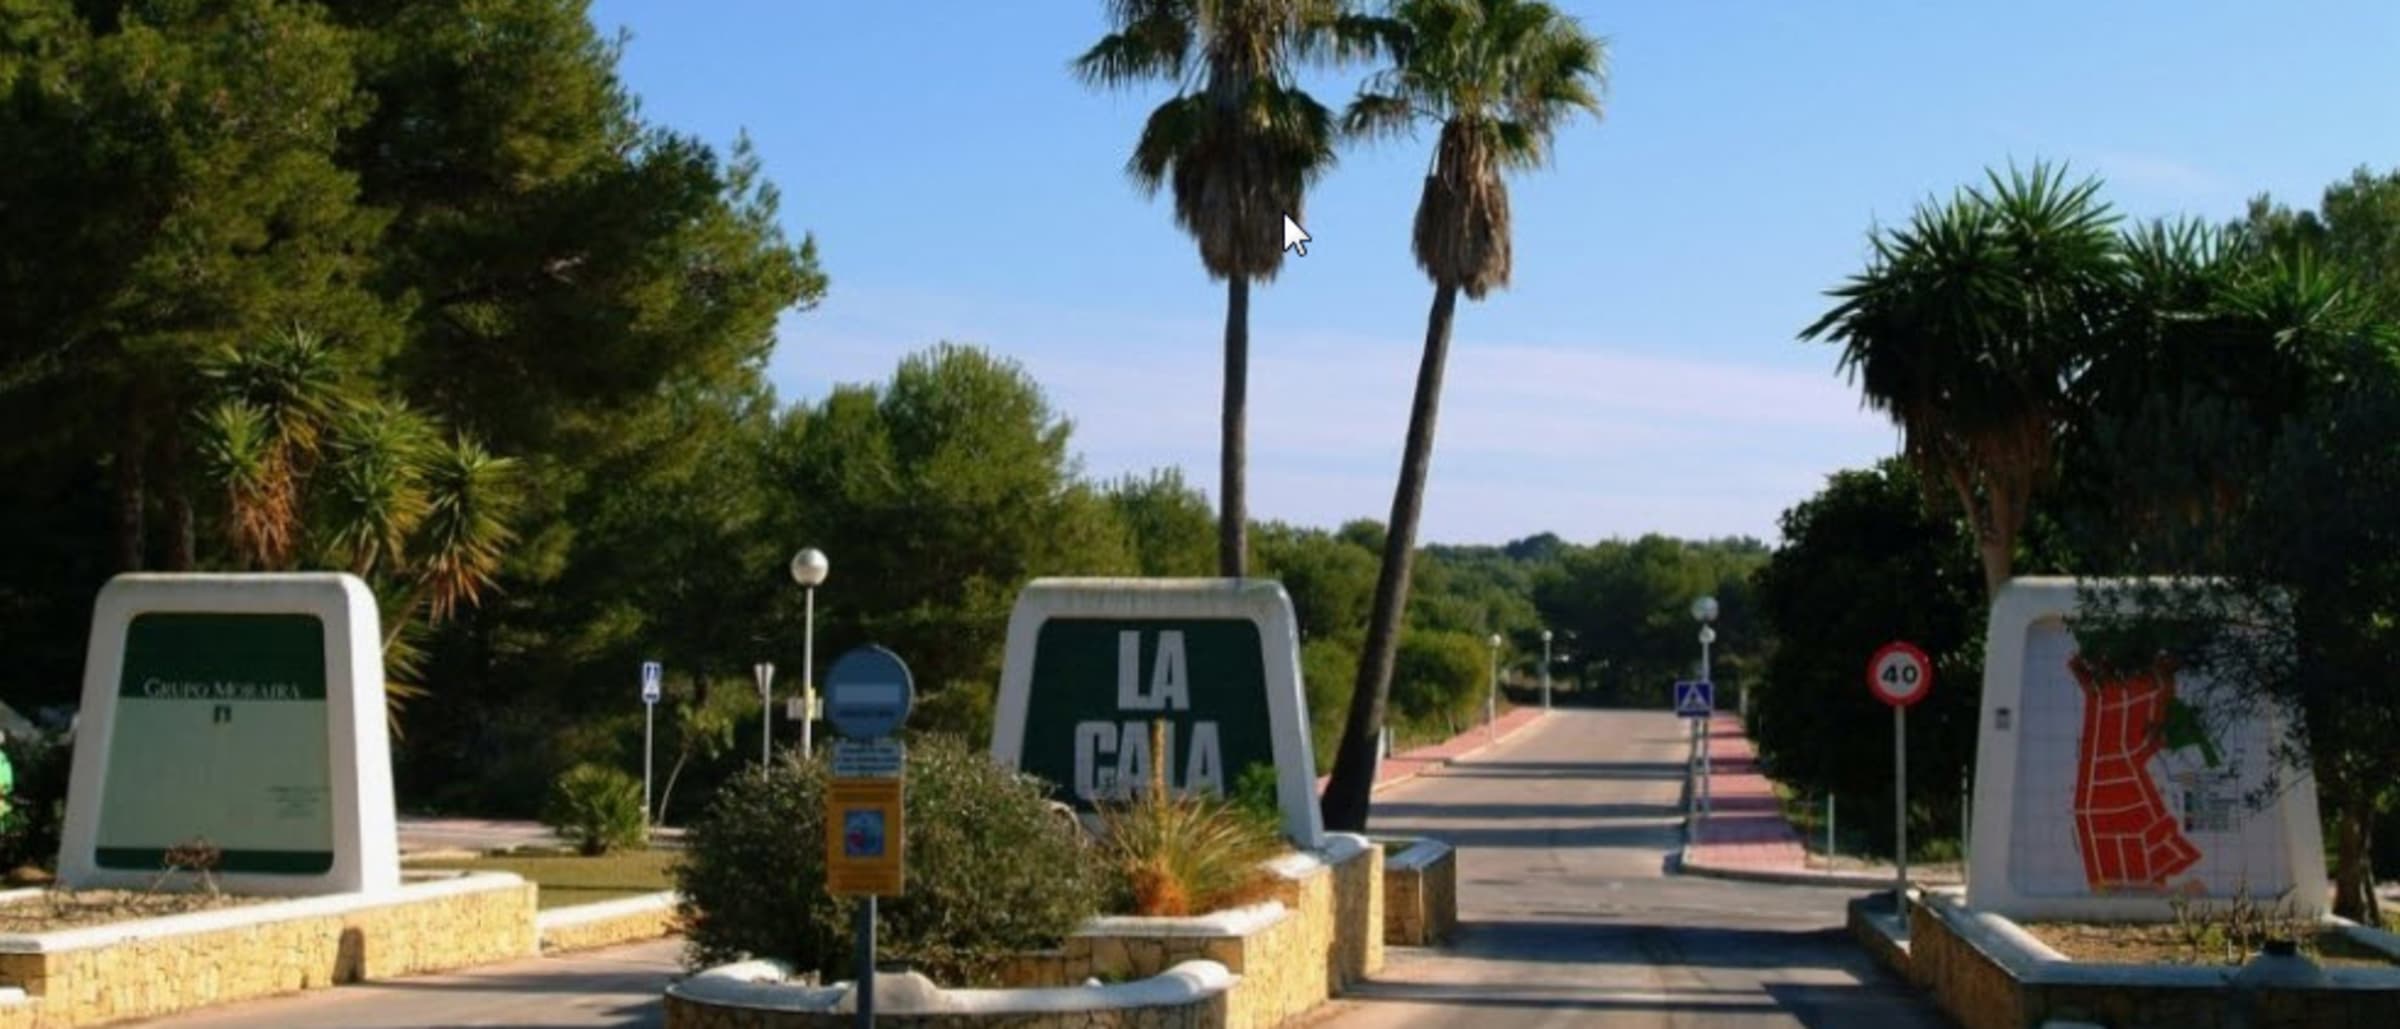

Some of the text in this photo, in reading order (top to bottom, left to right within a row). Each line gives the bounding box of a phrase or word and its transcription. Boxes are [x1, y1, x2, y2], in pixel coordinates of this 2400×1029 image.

[1118, 629, 1190, 710] LA
[1882, 664, 1918, 685] 40
[143, 677, 209, 699] GRUPO
